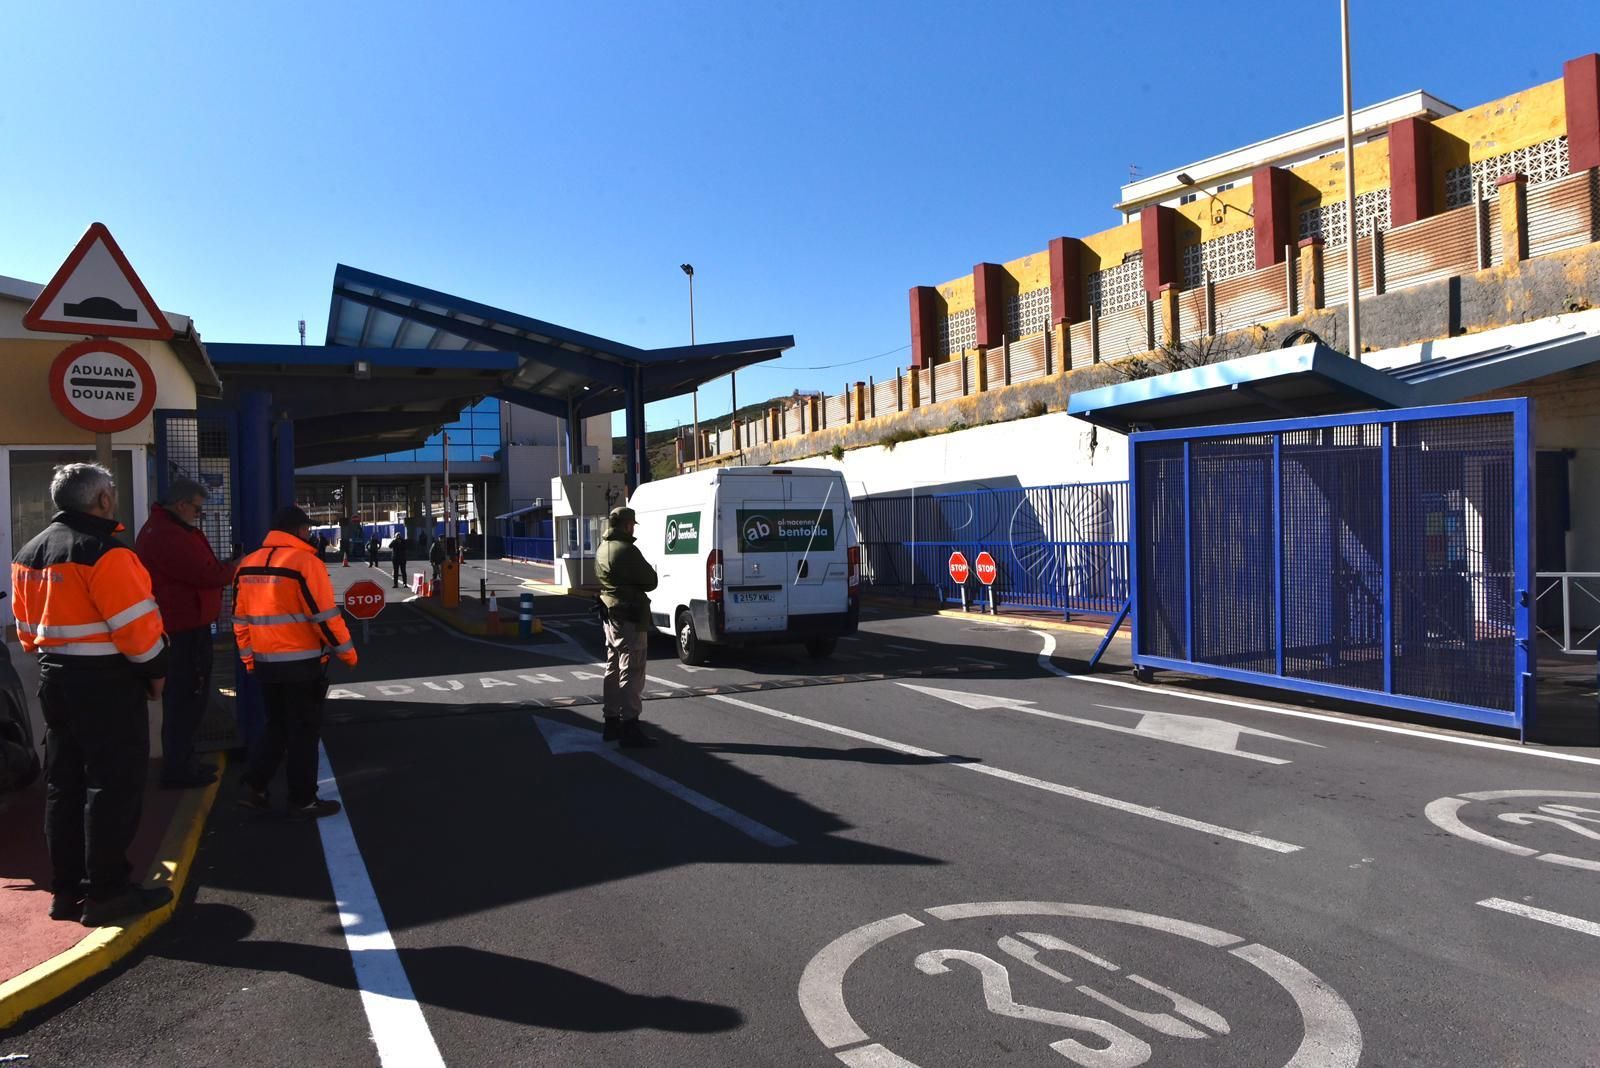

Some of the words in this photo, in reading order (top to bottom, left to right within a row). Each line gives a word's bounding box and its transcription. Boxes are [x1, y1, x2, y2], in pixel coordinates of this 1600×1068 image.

[72, 365, 134, 378] ADUANA
[72, 389, 135, 401] DOUANE
[746, 521, 770, 541] ab
[951, 564, 967, 572] STOP
[977, 564, 994, 573] STOP
[347, 594, 382, 605] STOP
[327, 670, 606, 699] ADUANA
